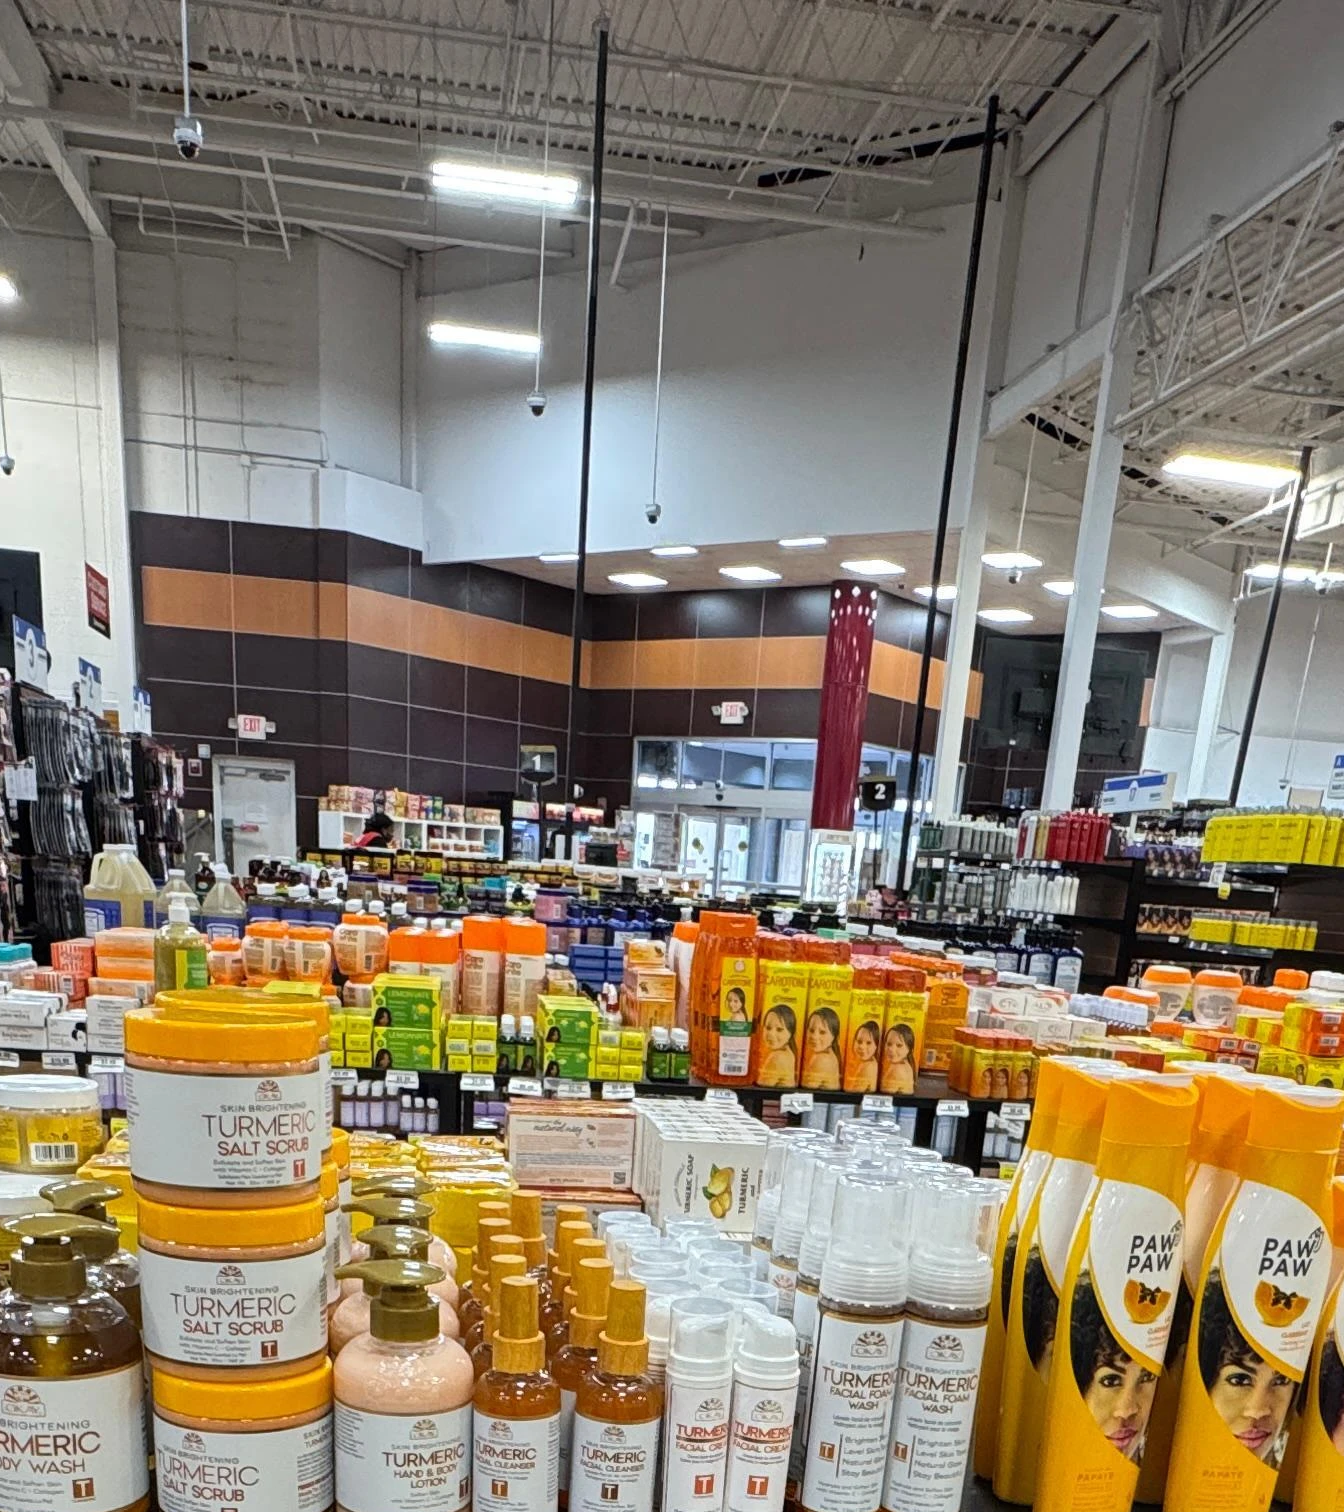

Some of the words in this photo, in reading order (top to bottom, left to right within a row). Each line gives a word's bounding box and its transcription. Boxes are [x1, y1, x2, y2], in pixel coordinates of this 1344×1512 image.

[28, 644, 34, 667] 3
[244, 718, 261, 732] EXIT
[533, 755, 541, 771] 1
[874, 784, 886, 799] 2
[202, 1110, 316, 1138] TURMERIC
[218, 1141, 261, 1157] SALT
[267, 1137, 309, 1156] SCRUB
[1131, 1235, 1176, 1254] PAW
[1263, 1238, 1315, 1259] PAW
[1127, 1252, 1174, 1274] PAW
[1258, 1257, 1313, 1277] PAW
[170, 1293, 297, 1319] TURMERIC
[183, 1319, 220, 1335] SALT
[228, 1320, 284, 1336] SCRUB
[904, 1389, 939, 1402] FACIAL
[921, 1403, 954, 1414] WASH
[382, 1444, 465, 1467] TURMERIC
[581, 1444, 647, 1464] TURMERIC
[29, 1458, 86, 1475] WASH
[394, 1469, 425, 1478] HAND
[426, 1467, 434, 1477] &
[436, 1462, 457, 1476] BODY
[580, 1458, 604, 1471] FACIAL
[605, 1464, 645, 1473] CLEANSER
[410, 1477, 447, 1489] LOTION
